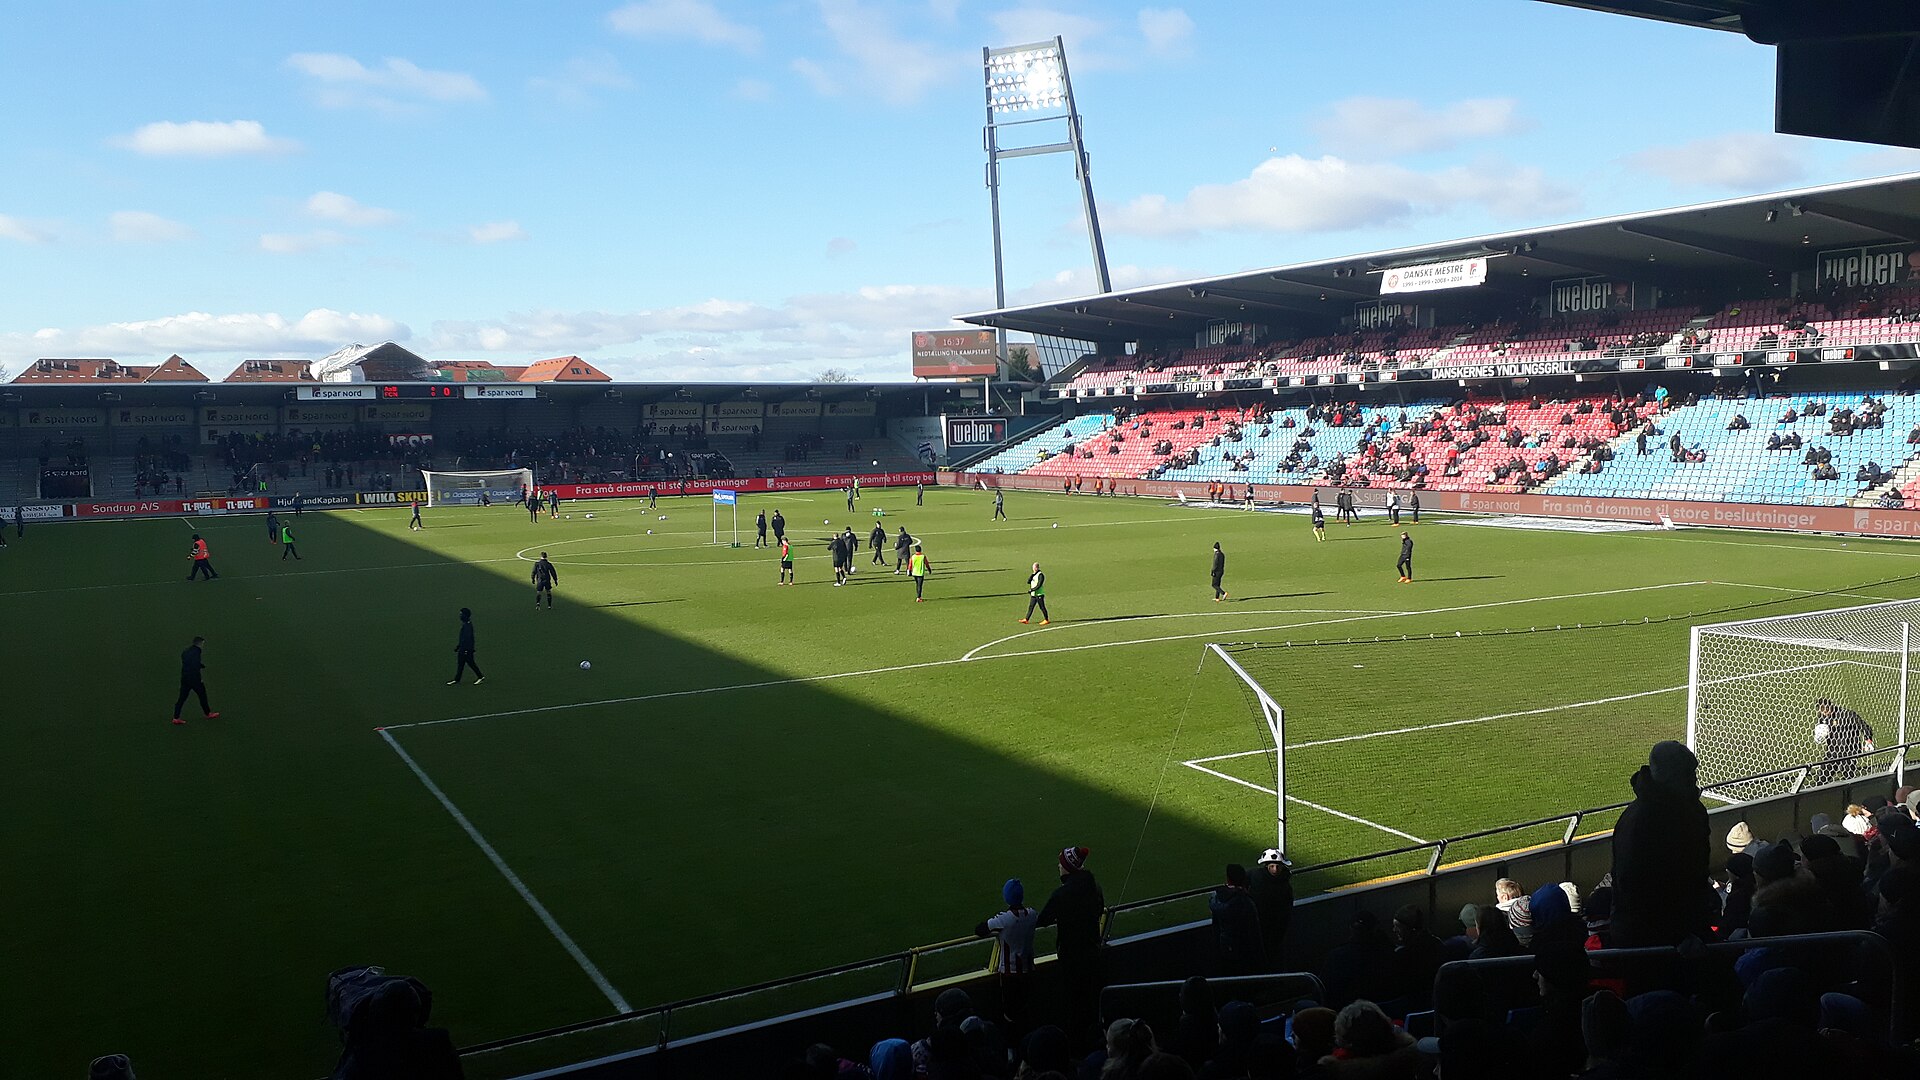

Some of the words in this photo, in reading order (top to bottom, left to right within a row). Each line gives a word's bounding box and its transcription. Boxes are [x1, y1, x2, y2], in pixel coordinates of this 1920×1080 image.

[1403, 268, 1433, 279] DANSKE
[1435, 264, 1463, 275] MESTRE
[1825, 247, 1904, 287] weber
[1557, 278, 1612, 313] weber
[1823, 348, 1846, 360] weber
[1431, 365, 1495, 379] DANSKERNES
[1496, 361, 1575, 376] YNDLINGSGRILL
[952, 420, 993, 443] weber
[575, 486, 592, 495] Fra
[594, 483, 614, 494] små
[657, 480, 667, 490] til
[693, 477, 750, 489] beslutninger
[825, 476, 838, 484] Fra
[892, 474, 901, 482] til
[92, 504, 136, 513] Sondrup
[140, 502, 160, 511] A/S
[363, 493, 396, 504] WIKA
[1542, 499, 1562, 511] Fra
[1566, 500, 1592, 513] små
[1596, 502, 1652, 515] drømme
[1673, 506, 1710, 520] store
[1714, 507, 1817, 528] beslutninger
